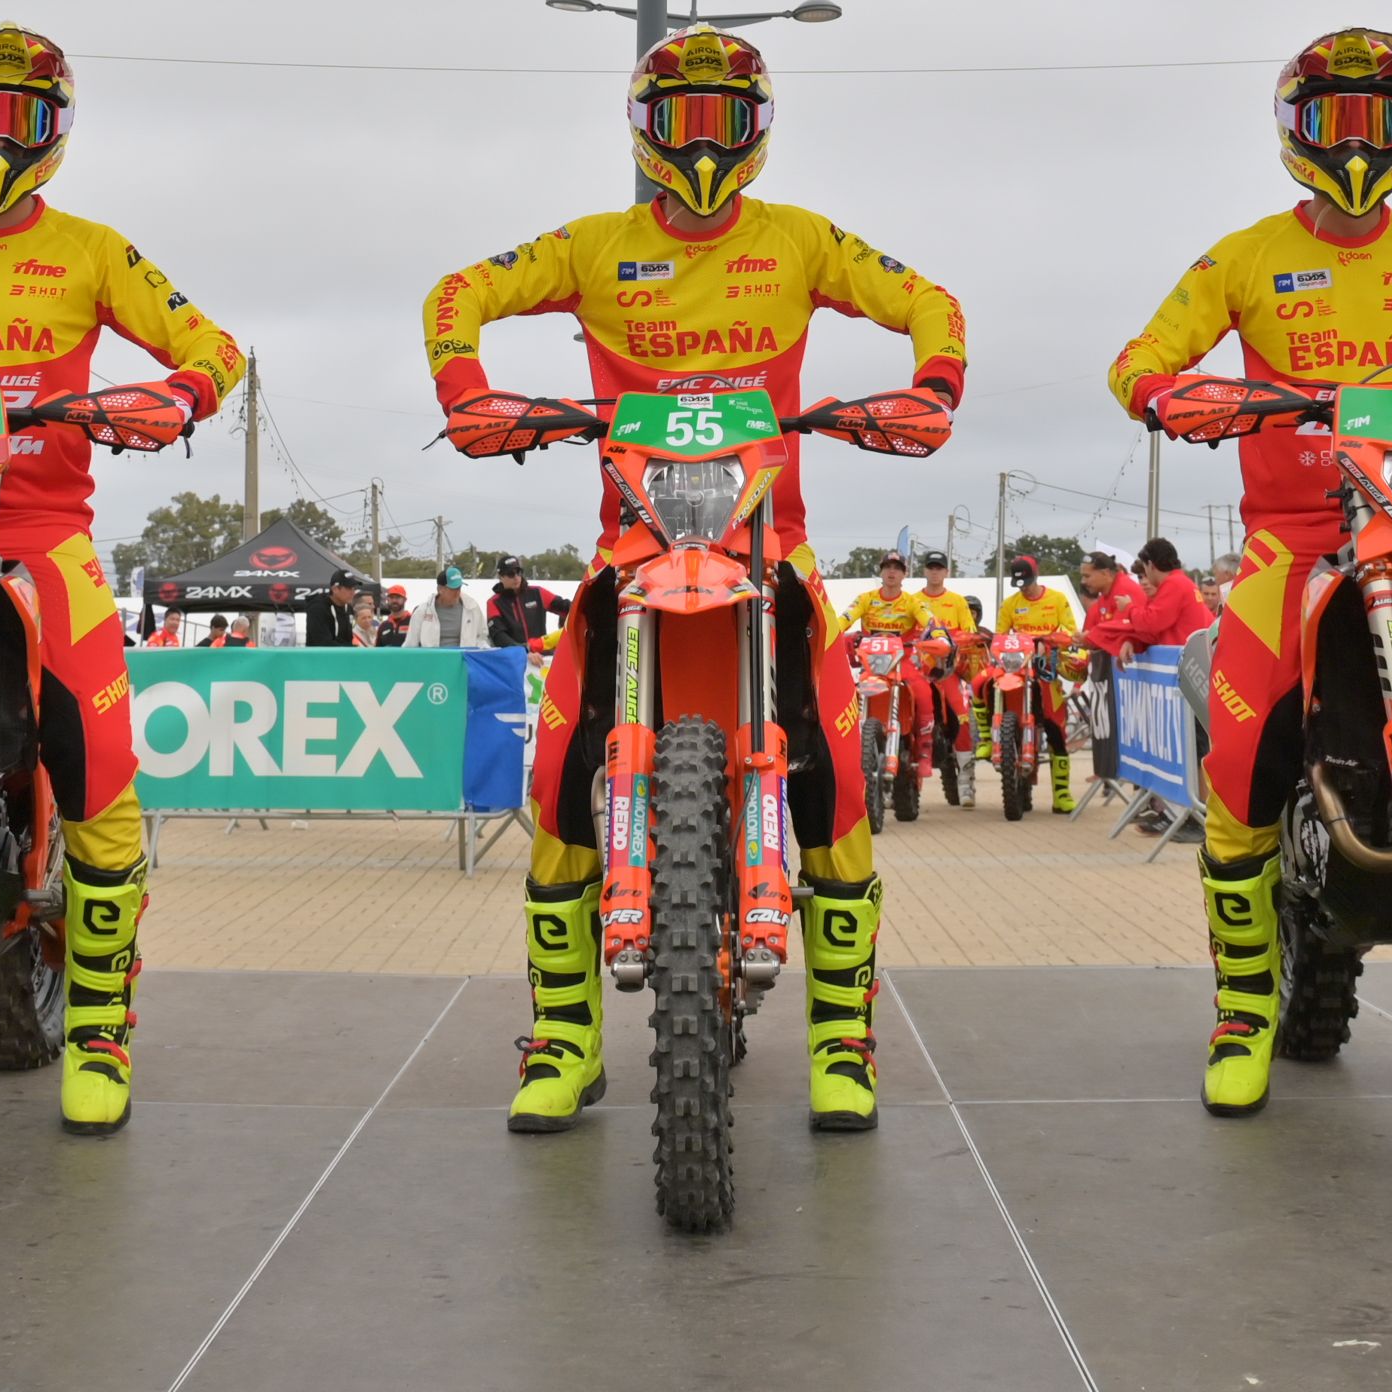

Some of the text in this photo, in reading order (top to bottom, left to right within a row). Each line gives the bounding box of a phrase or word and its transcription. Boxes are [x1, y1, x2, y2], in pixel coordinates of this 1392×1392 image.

[687, 46, 721, 57] AIROH
[1335, 46, 1370, 57] AIROH
[13, 258, 67, 278] rfme
[724, 253, 778, 274] rfme
[29, 285, 67, 298] SHOT
[744, 283, 781, 295] SHOT
[624, 320, 677, 333] Team
[627, 321, 778, 357] ESPAÑA
[1286, 329, 1338, 346] Team
[709, 371, 768, 388] AUGÉ
[616, 421, 641, 436] FIM
[665, 411, 723, 447] 55
[185, 585, 253, 599] 24MX
[626, 626, 640, 672] ERIC
[871, 640, 889, 652] 51
[1004, 640, 1019, 650] 53
[1212, 669, 1257, 723] SHOT
[132, 680, 424, 779] OREX
[612, 796, 630, 851] REDD
[631, 796, 646, 858] MOTOREX
[763, 794, 779, 851] REDD
